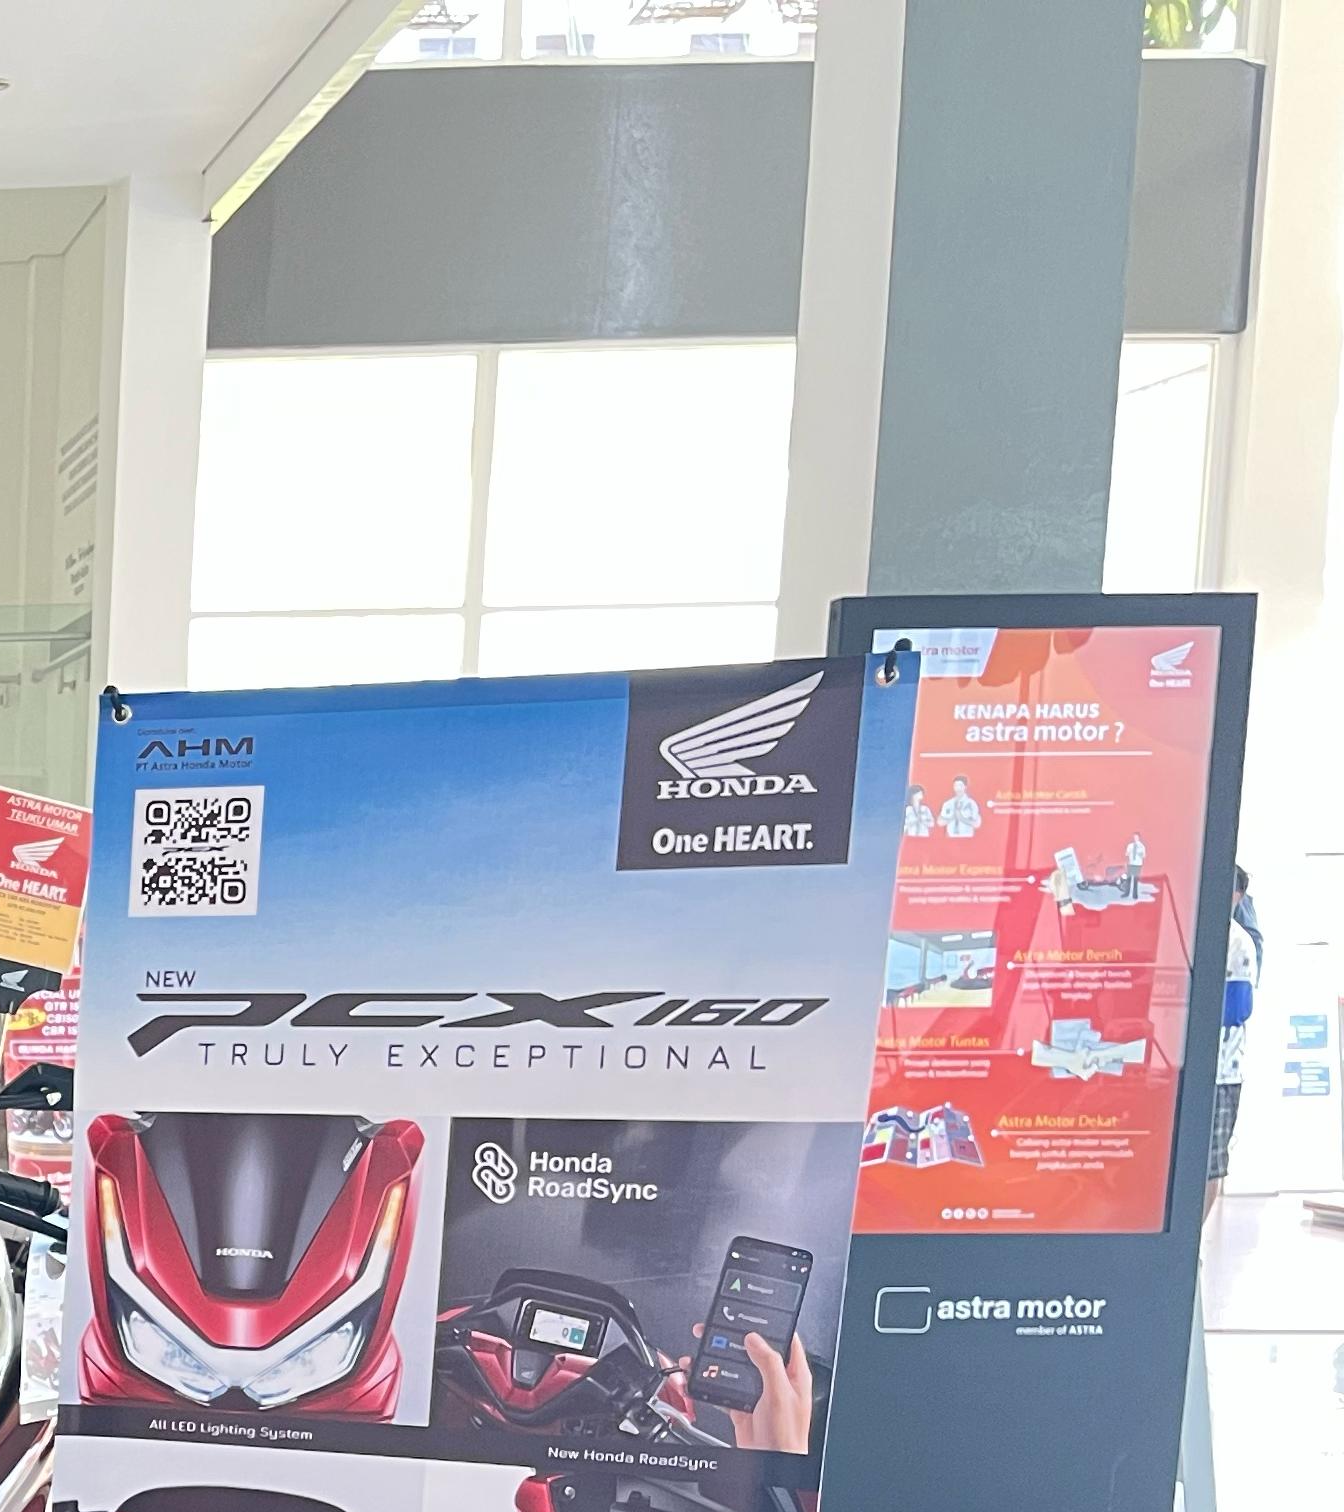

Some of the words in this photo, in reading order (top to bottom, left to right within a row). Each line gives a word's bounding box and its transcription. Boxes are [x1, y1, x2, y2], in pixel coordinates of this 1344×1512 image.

[941, 645, 980, 656] motor
[953, 703, 1031, 720] KENAPA
[1035, 702, 1100, 719] HARUS
[965, 723, 1029, 743] astra
[1033, 722, 1109, 742] motor
[1114, 721, 1125, 743] ?
[137, 737, 254, 759] AHM
[135, 762, 148, 772] PT
[151, 761, 178, 771] Astra
[181, 761, 216, 770] Honda
[218, 759, 252, 769] Motor
[656, 774, 818, 800] HONDA
[6, 795, 43, 812] ASTRA
[42, 803, 83, 822] MOTOR
[10, 808, 45, 826] TEUKU
[45, 817, 79, 834] UMAR
[652, 827, 709, 855] One
[713, 823, 814, 852] HEART.
[9, 860, 59, 879] HONDA
[22, 878, 68, 902] HEART.
[1014, 950, 1044, 961] Astra
[1046, 949, 1083, 961] Motor
[145, 970, 196, 988] NEW
[909, 1035, 947, 1048] Motor
[948, 1035, 990, 1048] Tuntas
[197, 1042, 349, 1067] TRULY
[386, 1043, 767, 1071] EXCEPTIONAL
[998, 1115, 1032, 1128] Astra
[1035, 1114, 1076, 1128] Motor
[1078, 1114, 1118, 1128] Dekat
[528, 1150, 613, 1175] Honda
[527, 1176, 659, 1204] RoadSync
[215, 1247, 275, 1260] HONDA
[937, 1295, 1011, 1320] astra
[1017, 1294, 1106, 1320] motor
[1056, 1325, 1067, 1335] of
[1068, 1325, 1104, 1335] ASTRA
[149, 1419, 167, 1431] All
[171, 1421, 196, 1433] LED
[200, 1423, 256, 1439] Lighting
[259, 1427, 313, 1441] System
[547, 1446, 581, 1461] New
[583, 1449, 635, 1464] Honda
[639, 1453, 719, 1471] RoadSync
